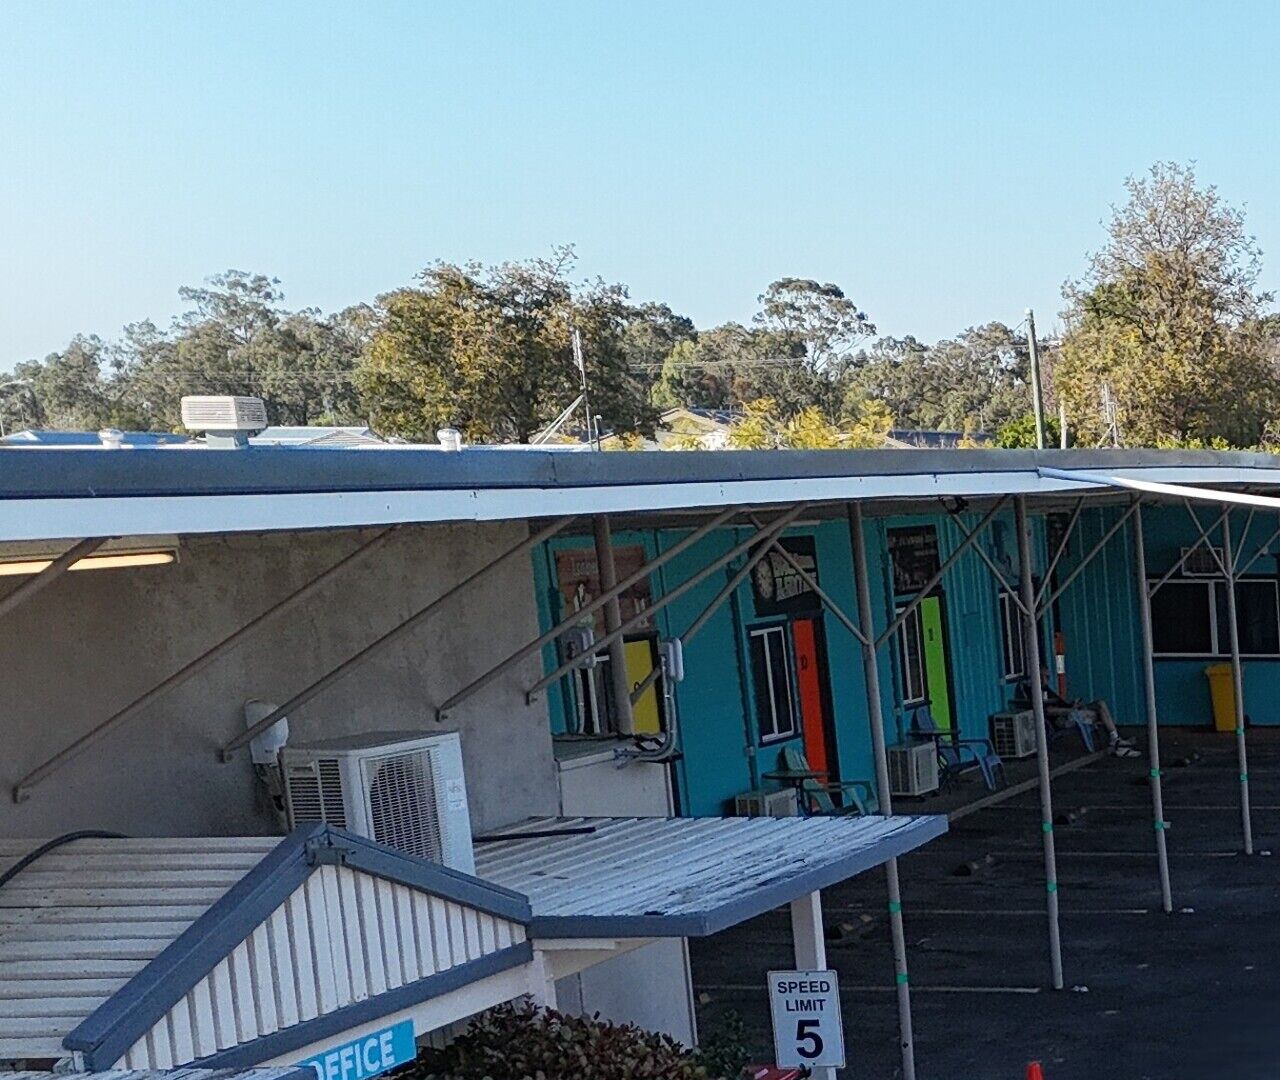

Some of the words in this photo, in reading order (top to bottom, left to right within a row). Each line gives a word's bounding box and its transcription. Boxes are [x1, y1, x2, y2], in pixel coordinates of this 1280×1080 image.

[777, 981, 830, 993] SPEED
[785, 999, 826, 1012] LIMIT
[796, 1019, 823, 1058] 5
